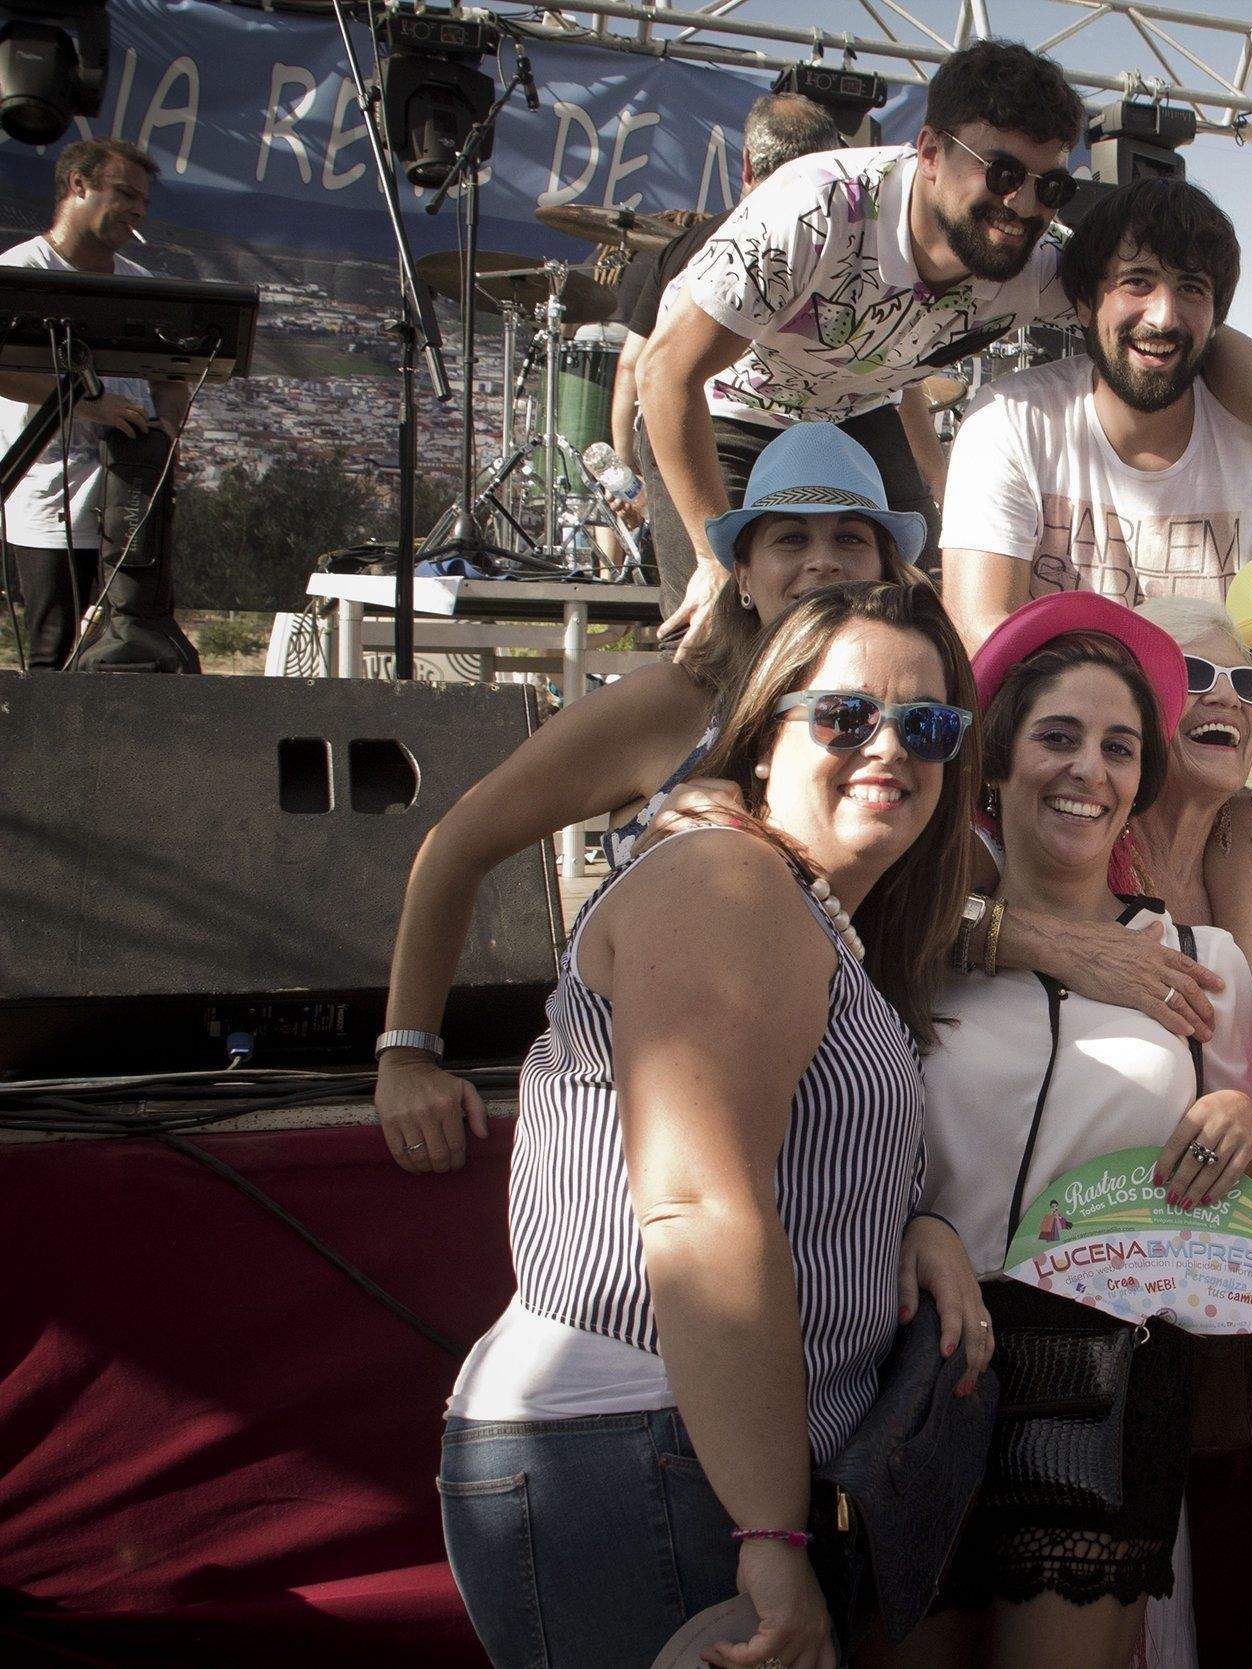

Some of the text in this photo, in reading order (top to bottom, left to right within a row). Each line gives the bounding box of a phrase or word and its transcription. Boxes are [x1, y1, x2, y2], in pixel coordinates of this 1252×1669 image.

[537, 101, 661, 214] DE
[1064, 1170, 1127, 1216] Rastro
[1079, 1202, 1106, 1217] Todos
[1107, 1188, 1138, 1206] LOS
[1107, 1276, 1136, 1292] Crea
[1144, 1277, 1177, 1294] WEB!
[1208, 1286, 1225, 1299] tus
